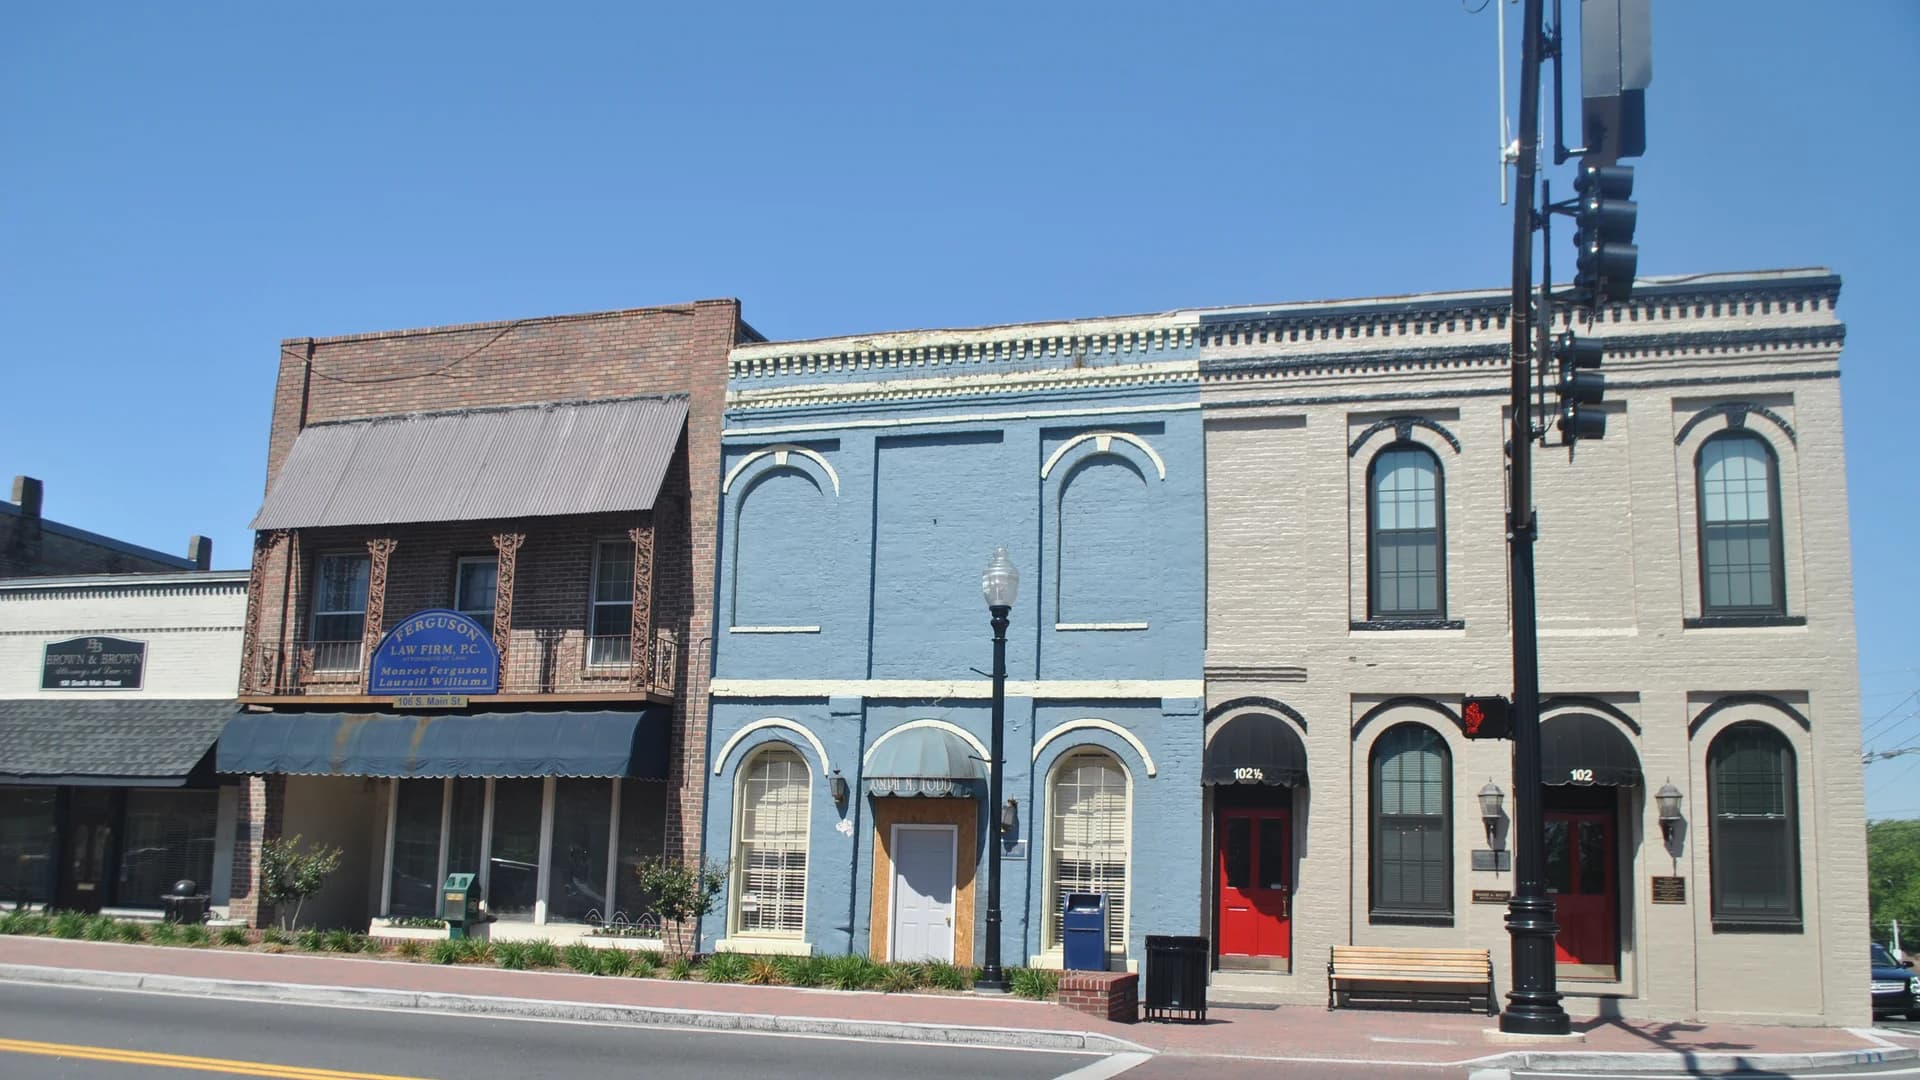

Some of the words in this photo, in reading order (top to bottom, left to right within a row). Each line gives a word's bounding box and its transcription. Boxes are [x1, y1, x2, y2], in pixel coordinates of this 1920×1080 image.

[395, 617, 479, 642] FERGUSON
[391, 644, 416, 656] LAW
[420, 644, 456, 656] FIRM,
[460, 644, 480, 655] P.C.
[46, 654, 86, 665] BROWN
[88, 655, 97, 665] &
[101, 653, 142, 665] BROWN
[381, 667, 426, 675] Monroe
[429, 666, 487, 677] Ferguson
[432, 677, 487, 687] Williams
[427, 696, 448, 706] Main
[1570, 769, 1593, 781] 102
[870, 778, 900, 791] JOSEPH
